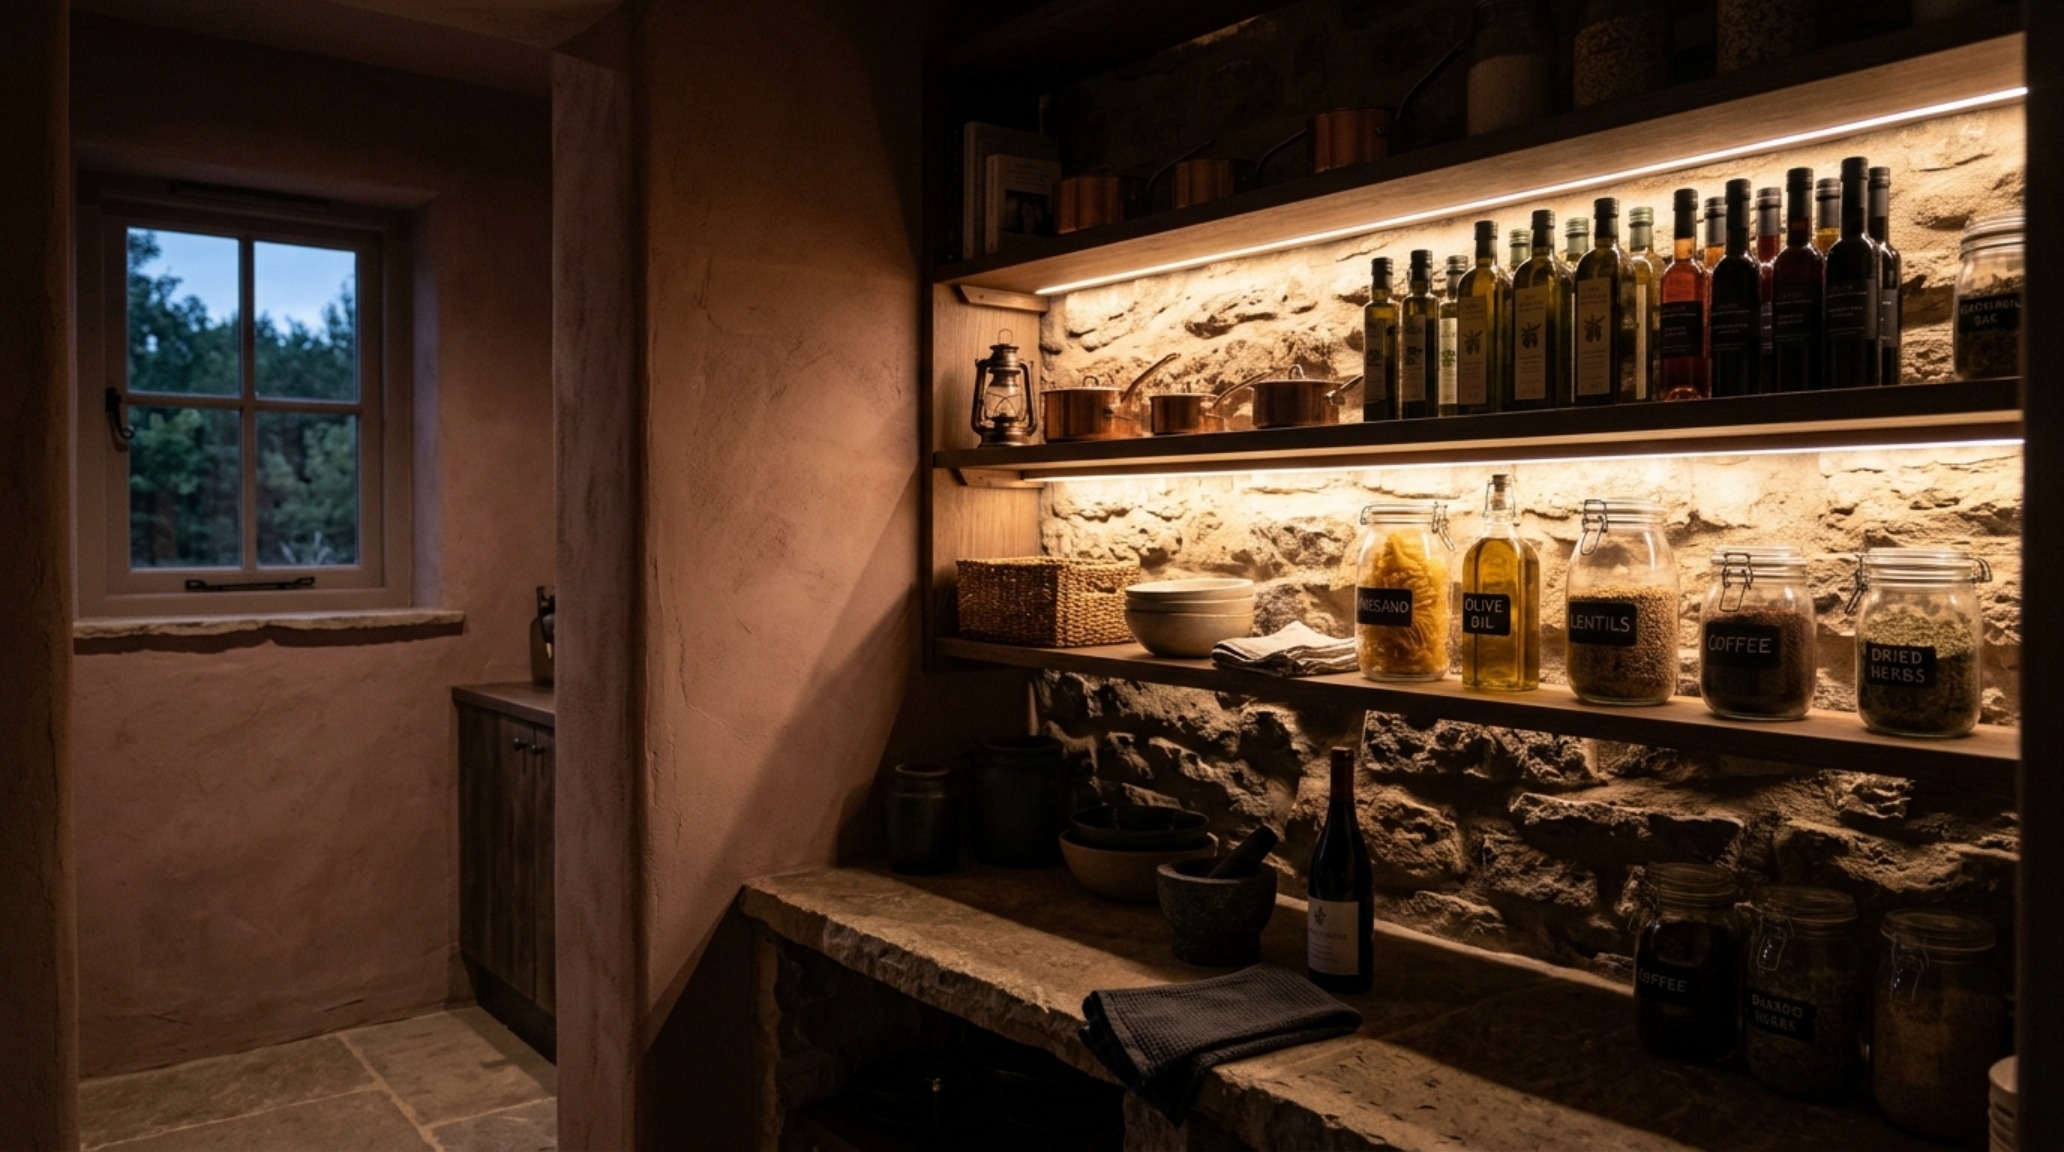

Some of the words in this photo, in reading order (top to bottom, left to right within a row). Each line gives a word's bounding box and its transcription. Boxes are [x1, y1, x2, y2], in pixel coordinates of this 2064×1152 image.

[1464, 597, 1504, 613] OLIVE
[1471, 615, 1495, 630] OIL
[1569, 613, 1631, 633] LENTILS
[1707, 633, 1773, 655] COFFEE
[1871, 646, 1923, 665] DRIED
[1870, 667, 1926, 685] HERBS
